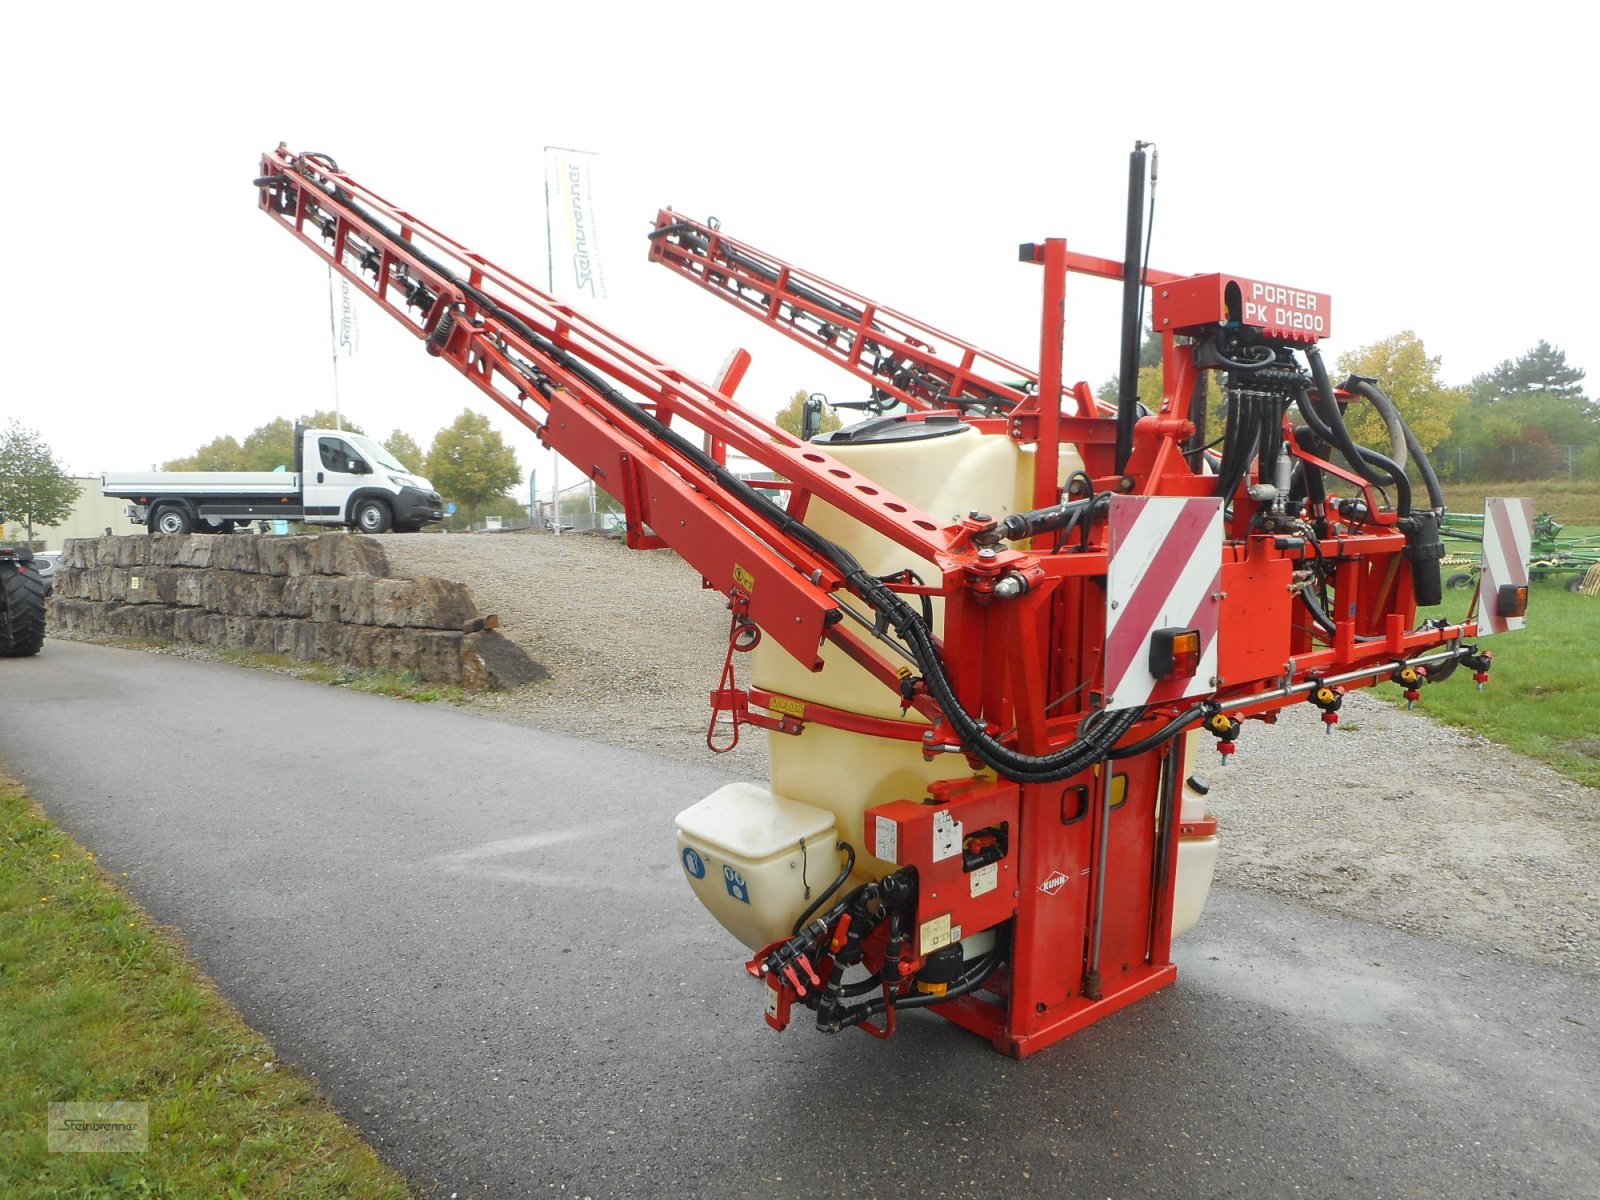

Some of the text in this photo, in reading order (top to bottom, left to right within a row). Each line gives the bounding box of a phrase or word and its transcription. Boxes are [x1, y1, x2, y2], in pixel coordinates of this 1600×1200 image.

[568, 163, 596, 299] Steinbrenner
[1252, 282, 1317, 311] PORTER
[1245, 302, 1324, 332] PK D1200
[1043, 875, 1066, 891] KUHN
